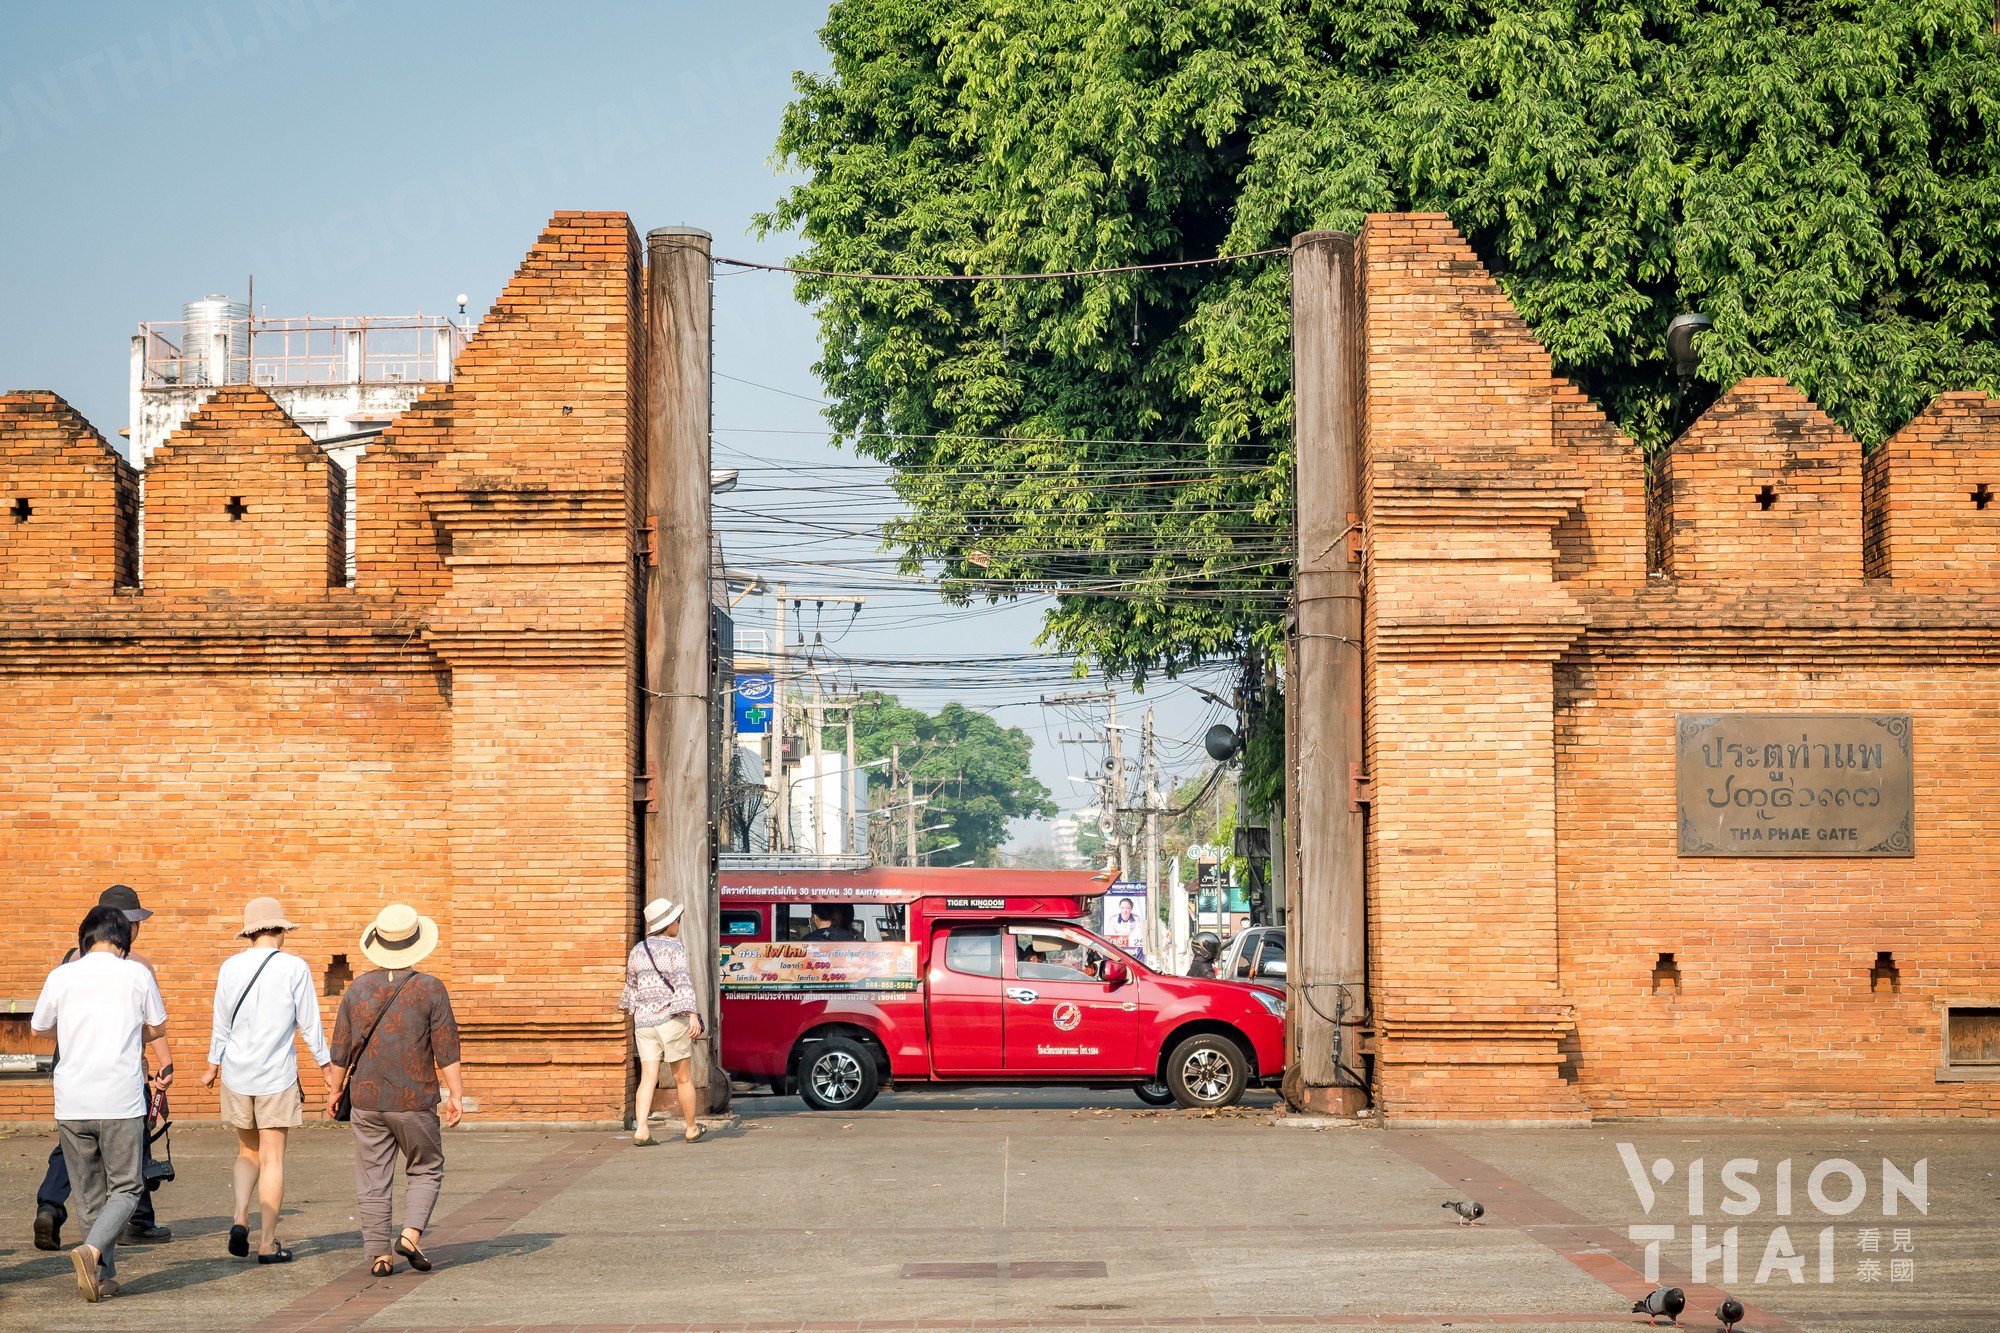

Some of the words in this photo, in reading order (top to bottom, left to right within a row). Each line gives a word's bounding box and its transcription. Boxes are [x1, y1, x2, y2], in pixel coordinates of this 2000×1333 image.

[1701, 733, 1883, 782] ประตูท่าแพ
[1730, 827, 1763, 841] THA
[1768, 827, 1811, 841] PHAE
[1816, 827, 1858, 841] GATE
[799, 887, 809, 896] 30
[811, 887, 840, 896] บาท/คน
[843, 887, 853, 896] 30
[855, 888, 903, 896] BAHT/PERSON
[946, 899, 969, 907] TIGER
[970, 899, 1005, 907] KINGDOM
[870, 991, 876, 1001] 2
